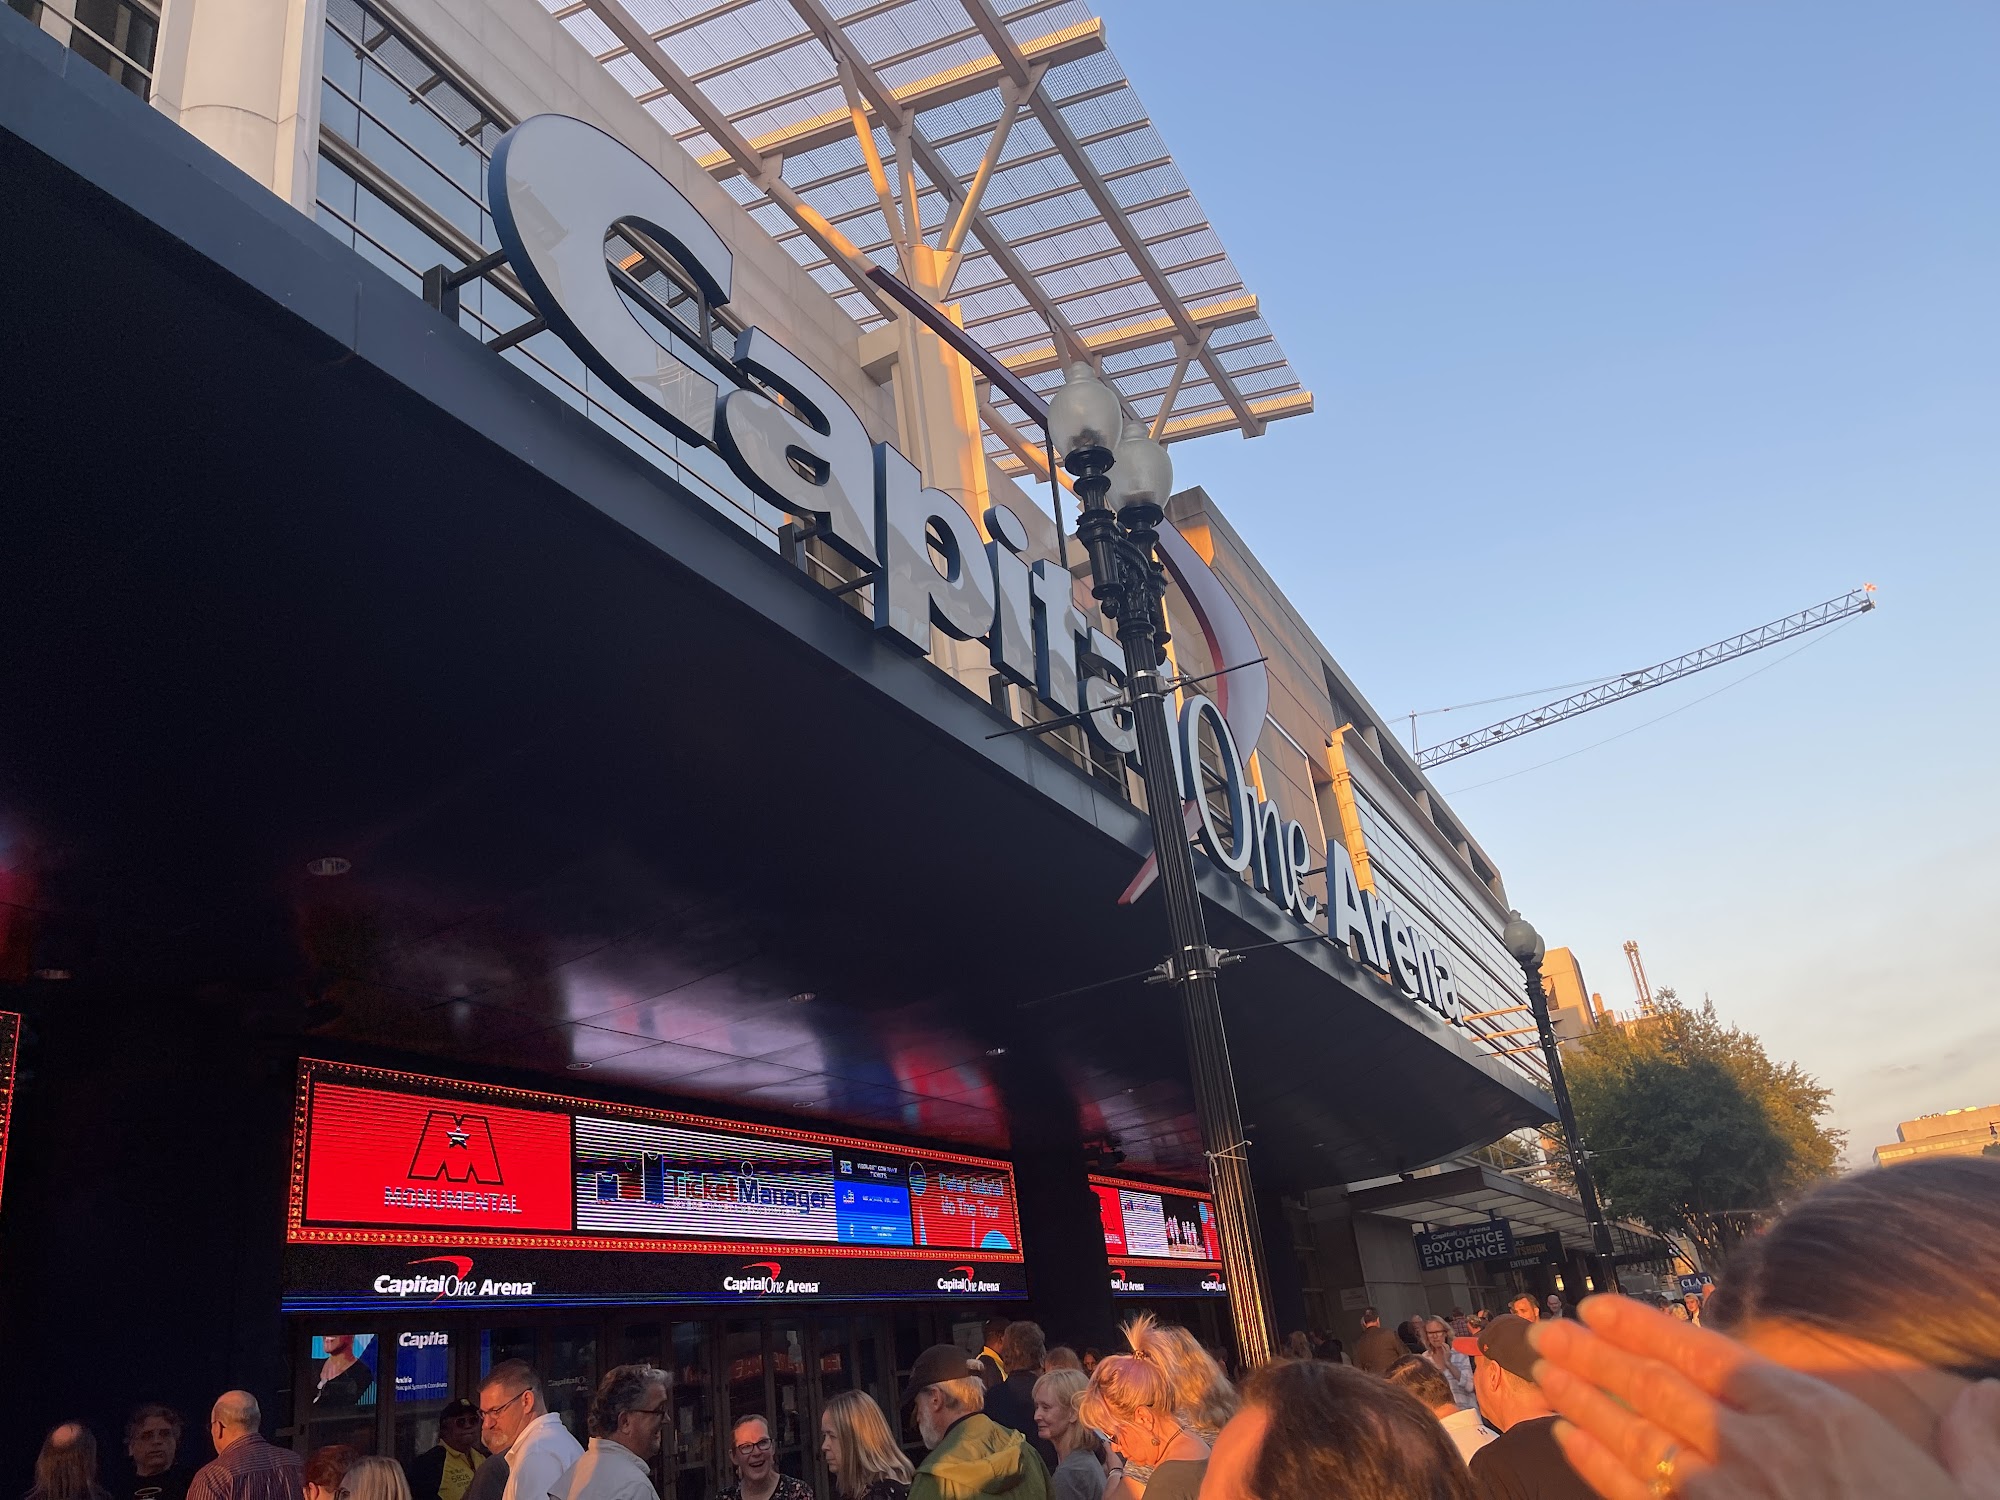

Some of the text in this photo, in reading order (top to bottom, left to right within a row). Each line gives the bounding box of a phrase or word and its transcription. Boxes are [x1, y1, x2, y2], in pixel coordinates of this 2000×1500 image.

[1327, 839, 1464, 1026] Arena
[384, 1186, 522, 1214] MONUMENTAL
[1468, 1226, 1491, 1235] Arena
[1422, 1240, 1452, 1255] BOX
[1454, 1230, 1505, 1248] OFFICE
[1425, 1243, 1508, 1268] ENTRANCE
[1510, 1257, 1541, 1268] ENTRANCE
[479, 1279, 534, 1296] Arena
[786, 1280, 819, 1293] Arena
[978, 1281, 1000, 1292] Arena
